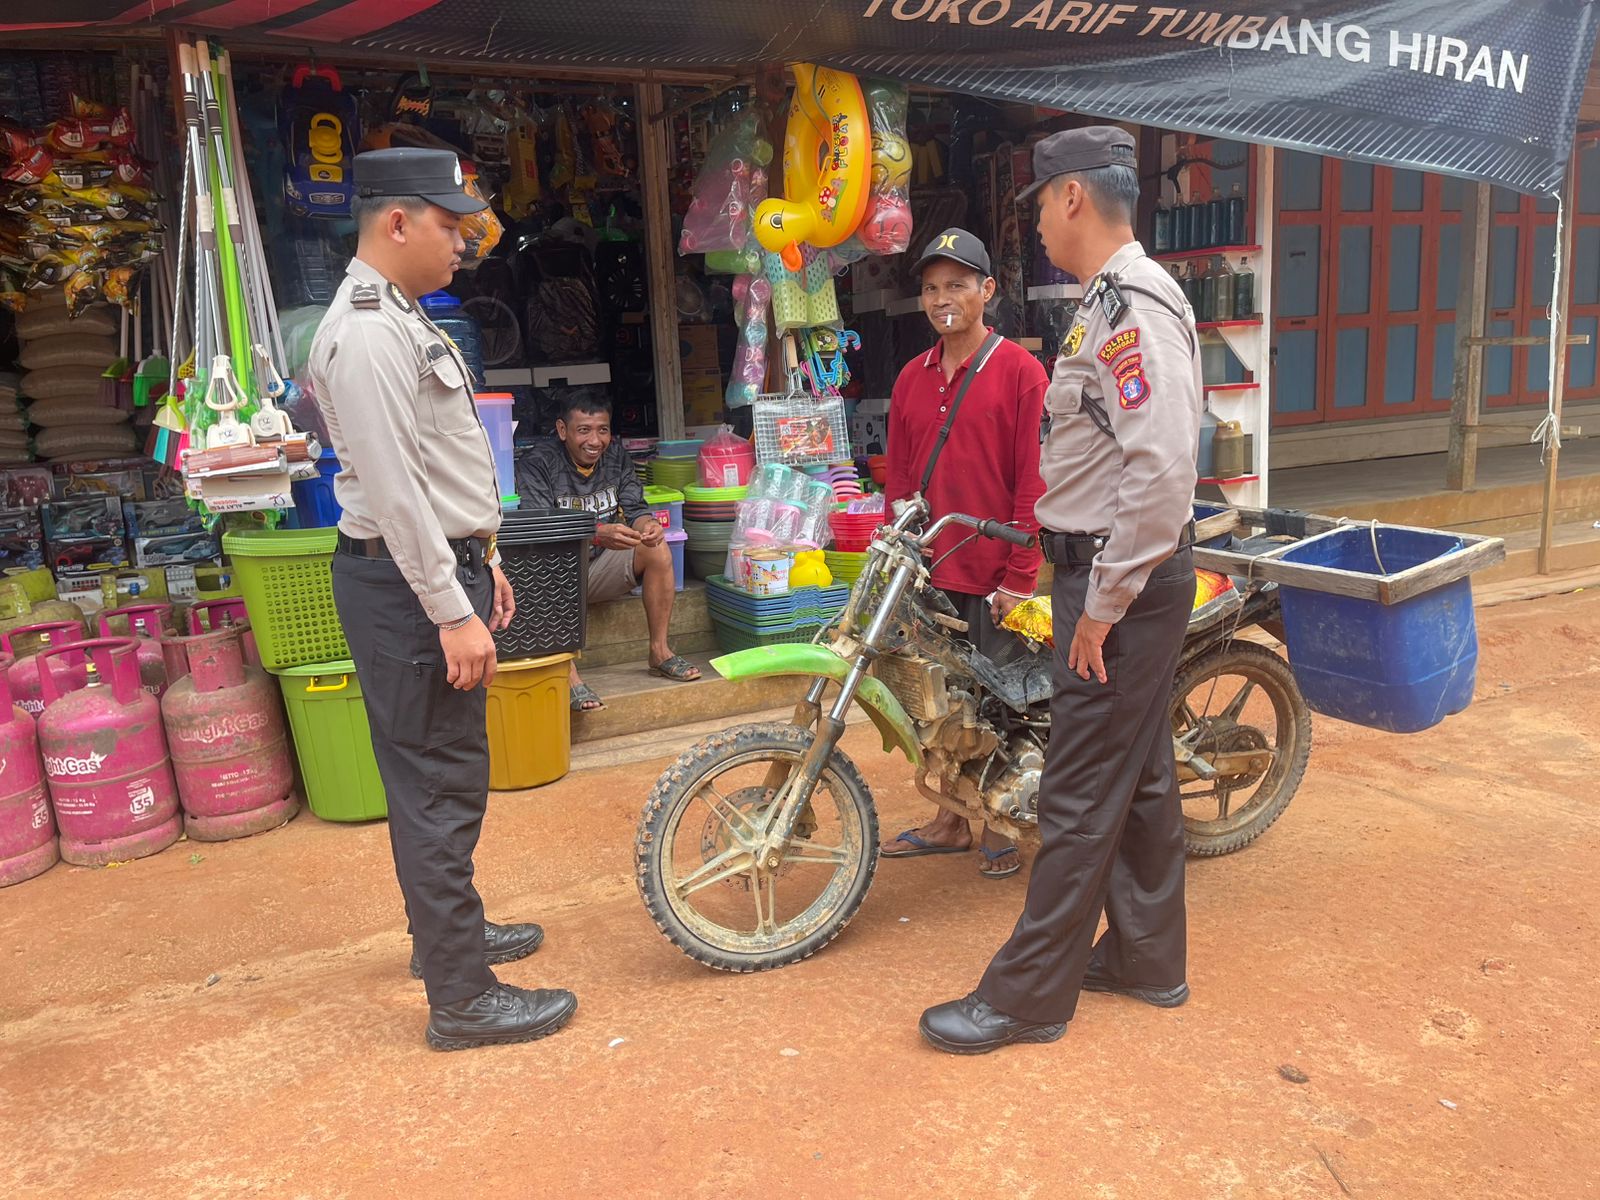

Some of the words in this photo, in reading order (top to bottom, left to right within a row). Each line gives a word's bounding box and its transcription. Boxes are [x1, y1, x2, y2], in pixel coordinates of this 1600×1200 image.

[863, 0, 1011, 26] TOKO
[1011, 0, 1137, 36] ARIF
[1137, 5, 1371, 64] TUMBANG
[1389, 30, 1529, 94] HIRAN
[839, 113, 849, 169] FLOAT
[1100, 330, 1137, 358] POLRES
[234, 711, 269, 733] Gas
[64, 757, 101, 776] Gas
[130, 796, 152, 812] 135
